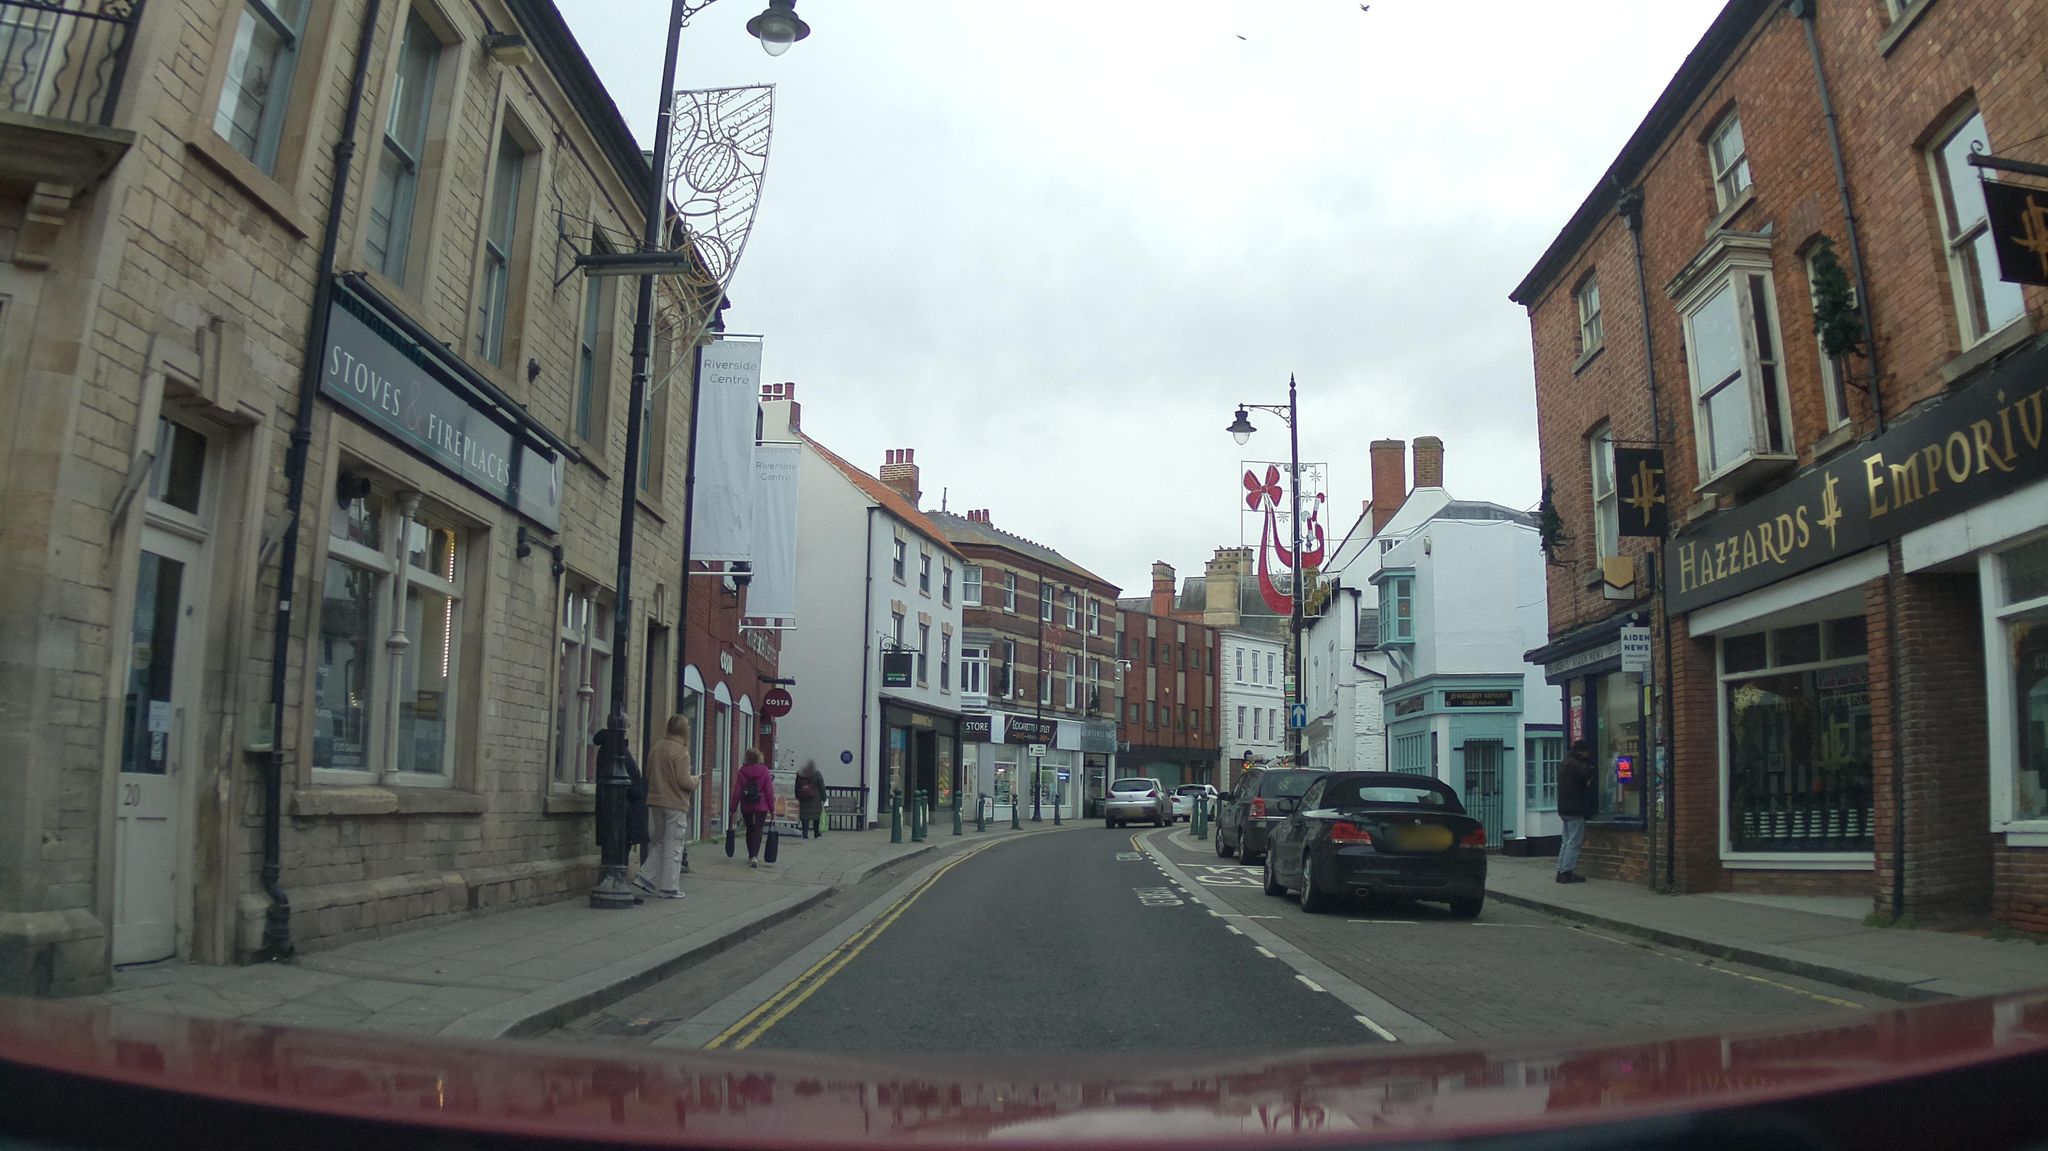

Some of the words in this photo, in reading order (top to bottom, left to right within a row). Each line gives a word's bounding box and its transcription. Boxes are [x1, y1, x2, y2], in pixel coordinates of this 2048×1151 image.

[703, 359, 758, 371] Riverside
[709, 373, 750, 385] Centre
[330, 345, 401, 417] STOVES
[405, 380, 422, 436] &
[427, 412, 511, 487] FIREPLACES
[755, 460, 798, 471] Riverside
[760, 472, 792, 482] Centre
[1678, 505, 1810, 594] HAZZARDS
[766, 698, 790, 706] COSTA
[966, 721, 989, 732] STORE
[123, 783, 142, 807] 20
